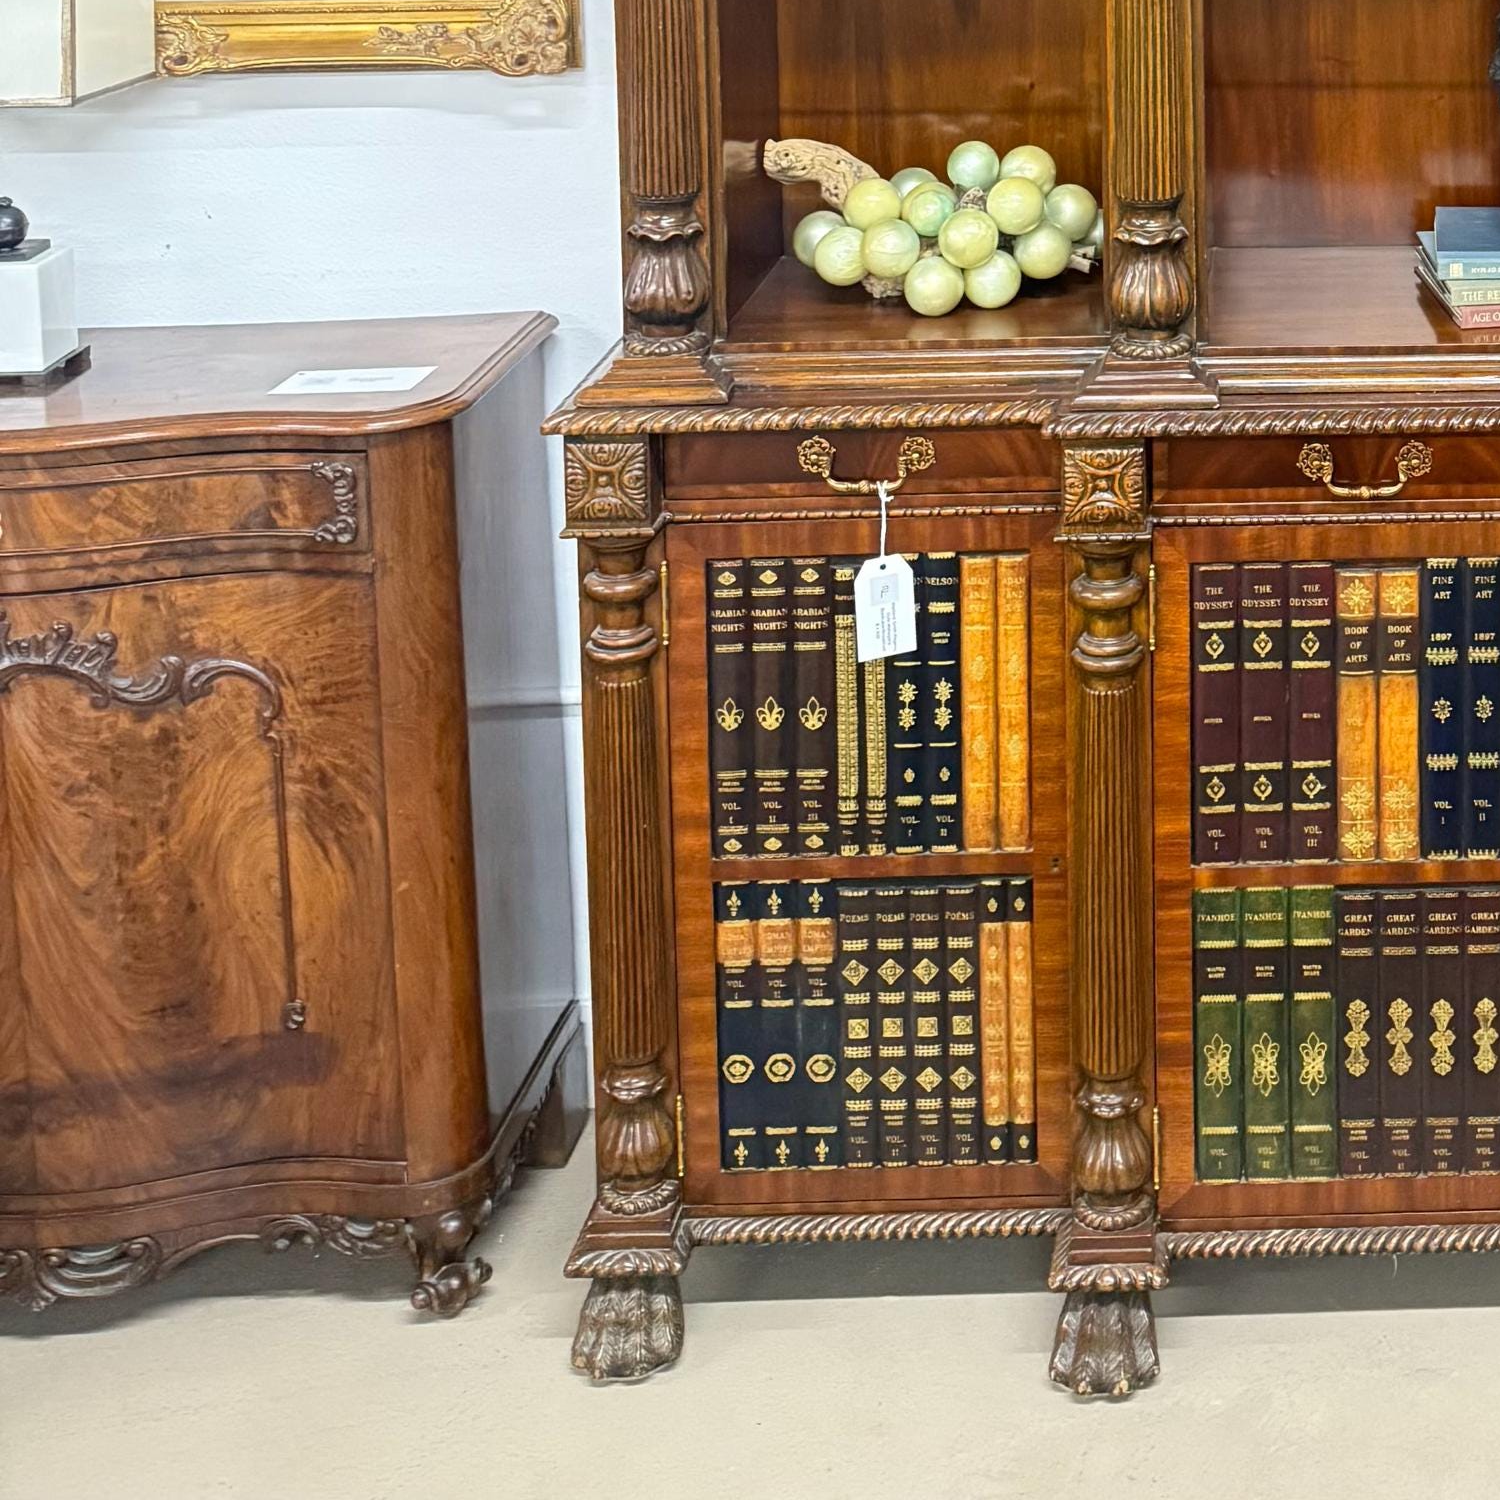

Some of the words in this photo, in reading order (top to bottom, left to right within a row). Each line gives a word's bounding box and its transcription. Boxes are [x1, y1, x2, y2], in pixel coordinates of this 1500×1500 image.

[1462, 291, 1484, 301] THE
[1473, 312, 1489, 321] AGE
[925, 577, 958, 586] NELSON
[1433, 576, 1453, 585] FINE
[1475, 575, 1496, 584] FINE
[1205, 587, 1223, 595] THE
[1254, 585, 1272, 593] THE
[1302, 584, 1321, 592] THE
[1434, 591, 1451, 600] ART
[1476, 590, 1492, 599] ART
[1195, 600, 1234, 610] ODYSSEY
[1242, 598, 1281, 608] ODYSSEY
[1290, 598, 1329, 607] ODYSSEY
[712, 623, 745, 632] NIGHTS
[753, 621, 787, 630] NIGHTS
[795, 620, 828, 629] NIGHTS
[1345, 626, 1369, 635] BOOK
[1388, 625, 1412, 634] BOOK
[1430, 632, 1452, 641] 1897
[1474, 632, 1495, 641] 1897
[1350, 641, 1362, 649] OF
[1394, 640, 1406, 648] OF
[1346, 654, 1368, 663] ARTS
[1388, 653, 1411, 662] ARTS
[1198, 913, 1236, 922] IVANHOE
[1245, 912, 1283, 921] IVANHOE
[1293, 910, 1331, 919] IVANHOE
[1344, 914, 1373, 923] GREAT
[1387, 914, 1415, 922] GREAT
[1429, 913, 1457, 922] GREAT
[1471, 912, 1500, 921] GREAT
